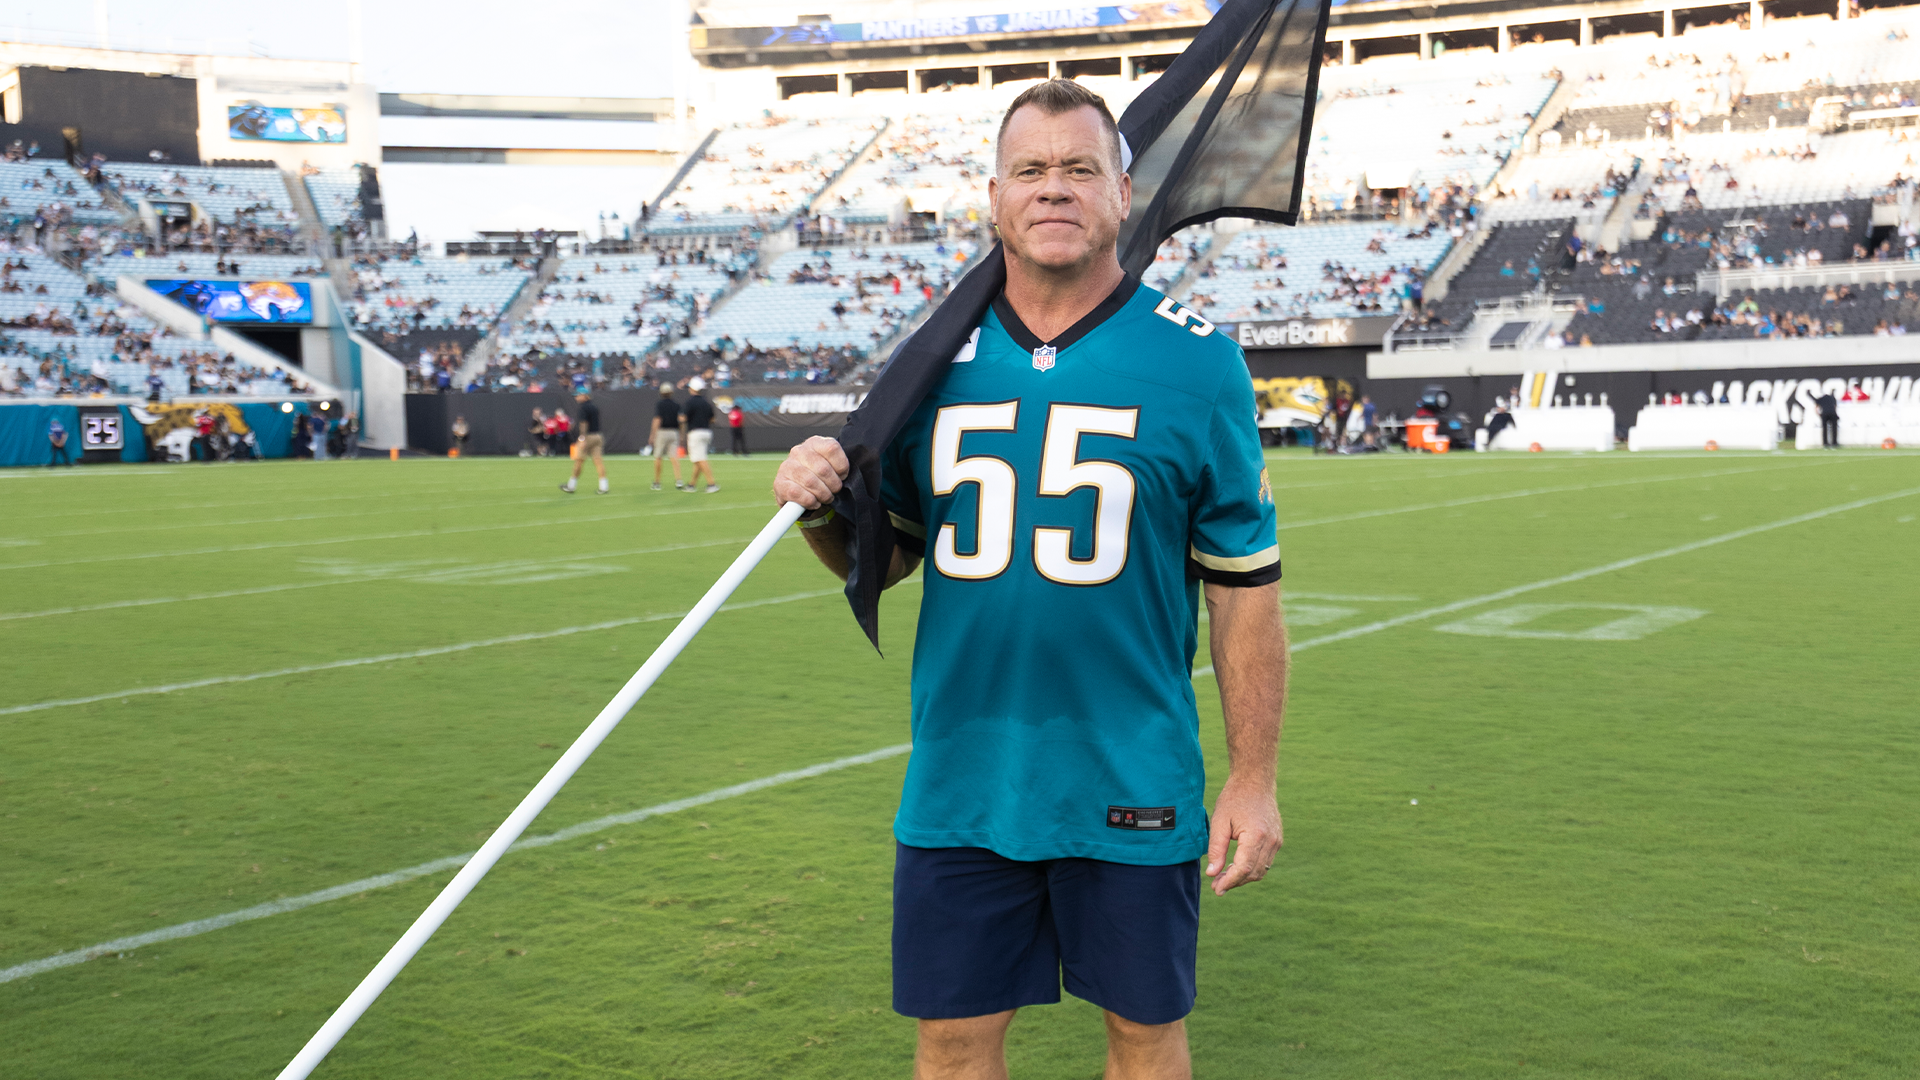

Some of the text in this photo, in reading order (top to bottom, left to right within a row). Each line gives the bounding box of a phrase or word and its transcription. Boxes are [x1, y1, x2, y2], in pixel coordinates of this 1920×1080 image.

[861, 17, 970, 41] PANTHERS
[1003, 7, 1100, 33] JAGUARS
[1239, 319, 1348, 346] EverBank
[1036, 356, 1052, 367] NFL
[86, 418, 119, 444] 25
[931, 397, 1142, 588] 55
